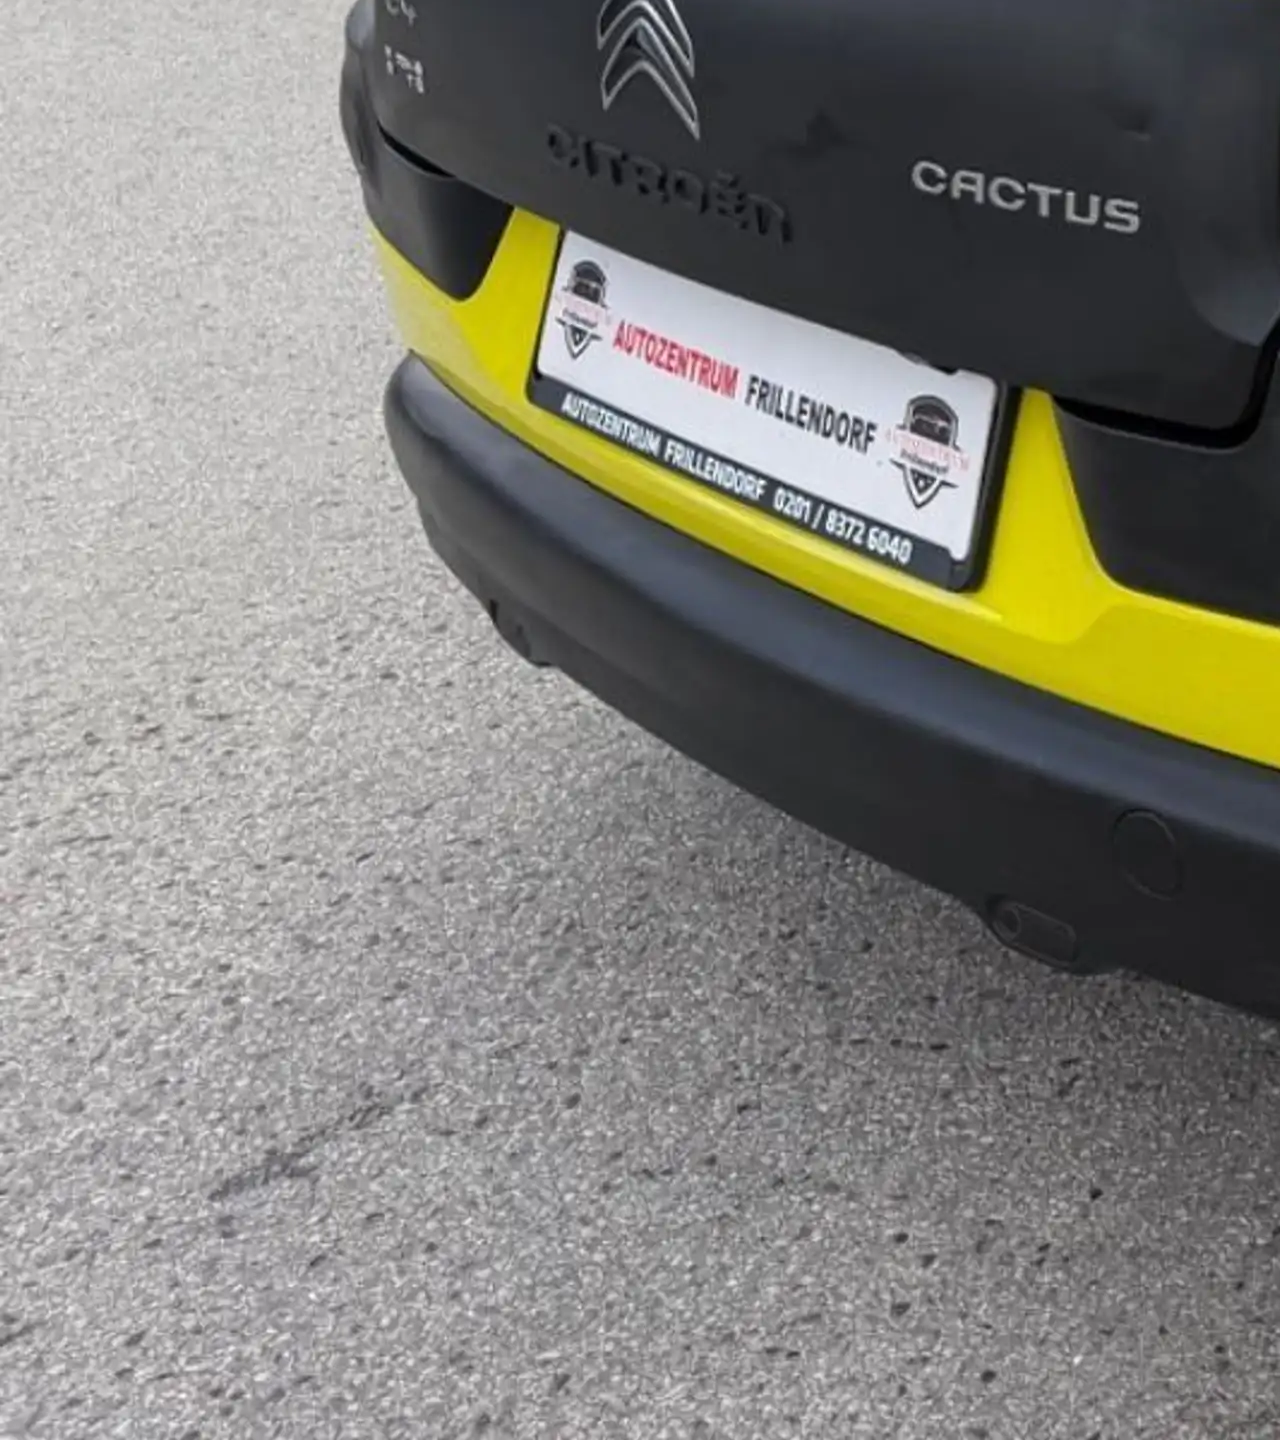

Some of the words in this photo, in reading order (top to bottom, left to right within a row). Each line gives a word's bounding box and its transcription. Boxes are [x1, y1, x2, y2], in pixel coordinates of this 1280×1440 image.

[911, 160, 1141, 234] CACTUS
[613, 320, 740, 398] AUTOZENTRUM
[745, 375, 878, 453] FRILLENDORF
[561, 392, 661, 458] AUTOZENTRUM
[664, 439, 767, 501] FRILLENDORF
[773, 486, 810, 526] 0201
[825, 508, 864, 544] 8372
[866, 527, 913, 565] 6040
